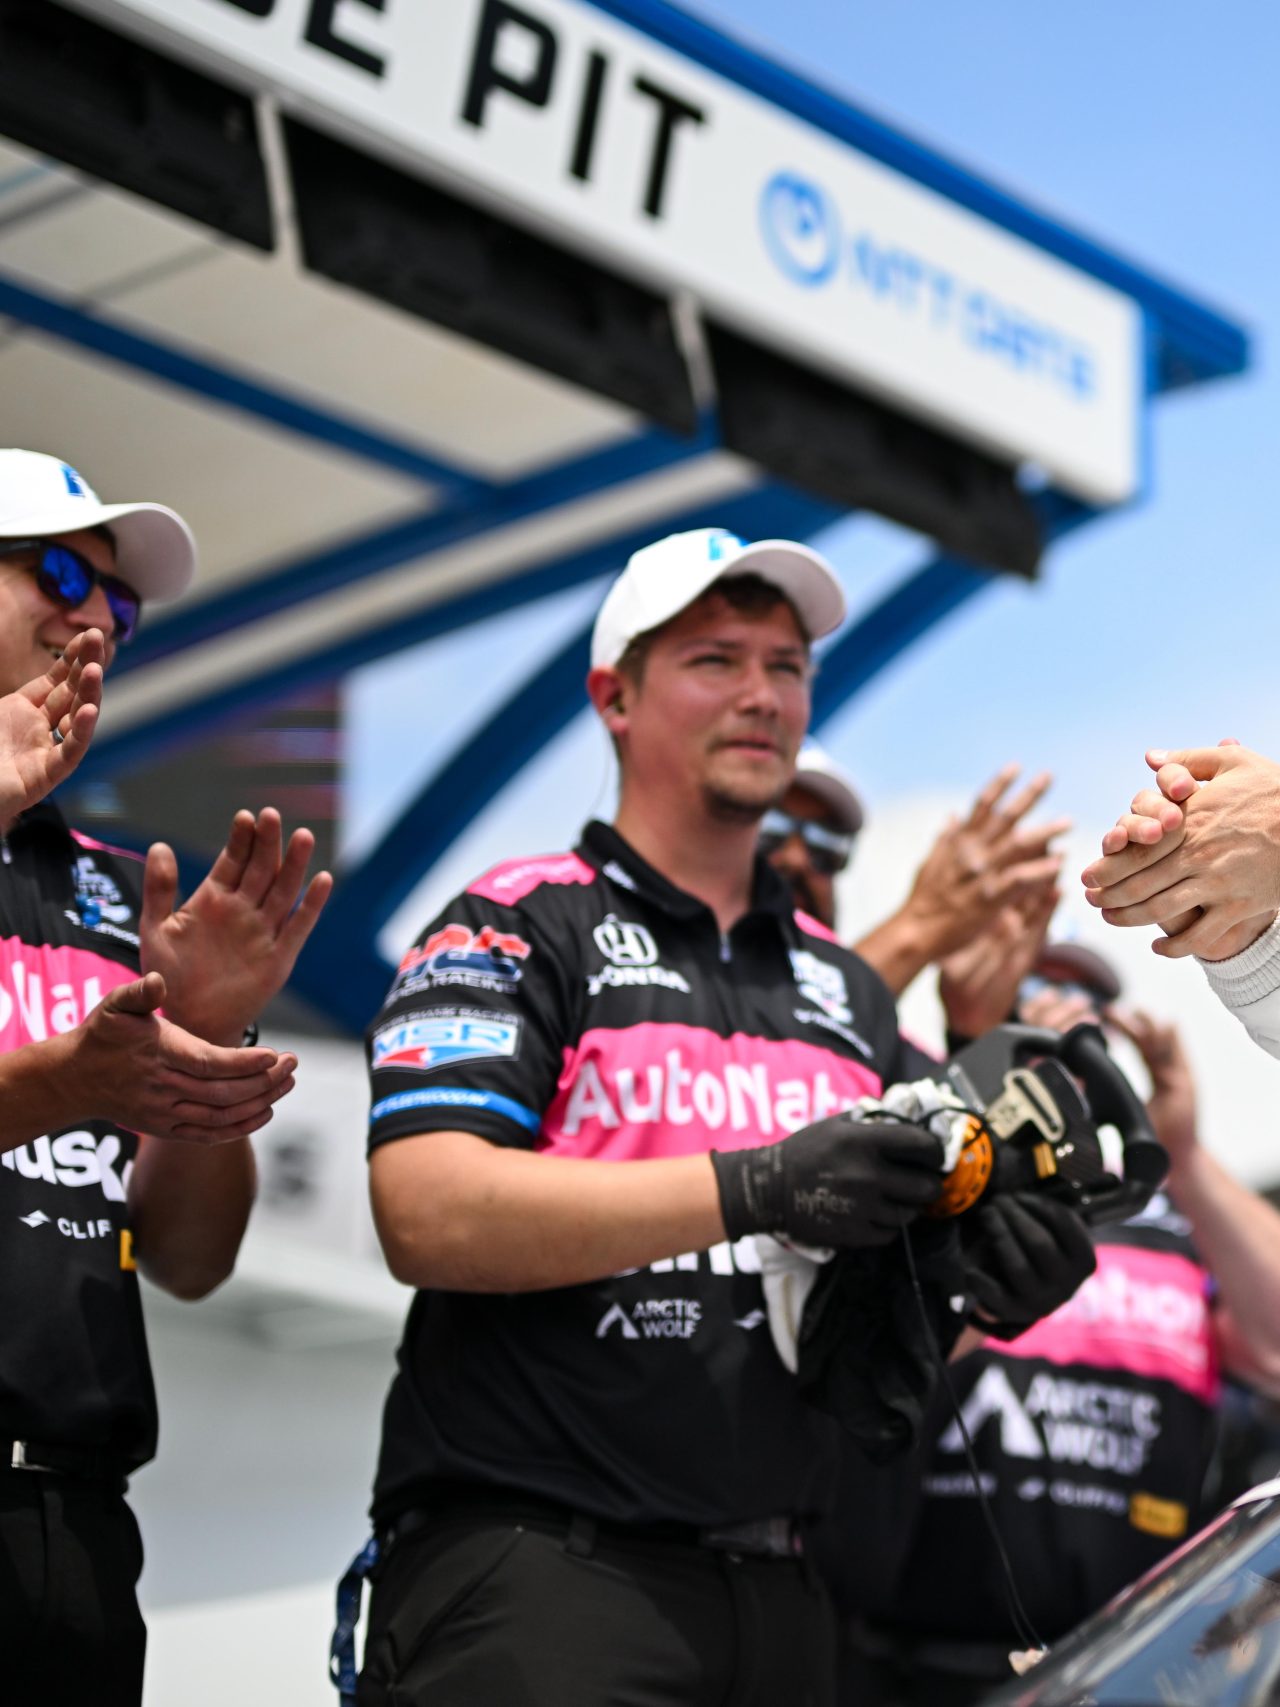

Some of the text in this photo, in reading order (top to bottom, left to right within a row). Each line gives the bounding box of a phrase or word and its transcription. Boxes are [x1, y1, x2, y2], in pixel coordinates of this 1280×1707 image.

[459, 0, 708, 219] PIT
[57, 1217, 113, 1239] CLIF
[632, 1299, 703, 1321] ARCTIC
[643, 1319, 698, 1339] WOLF
